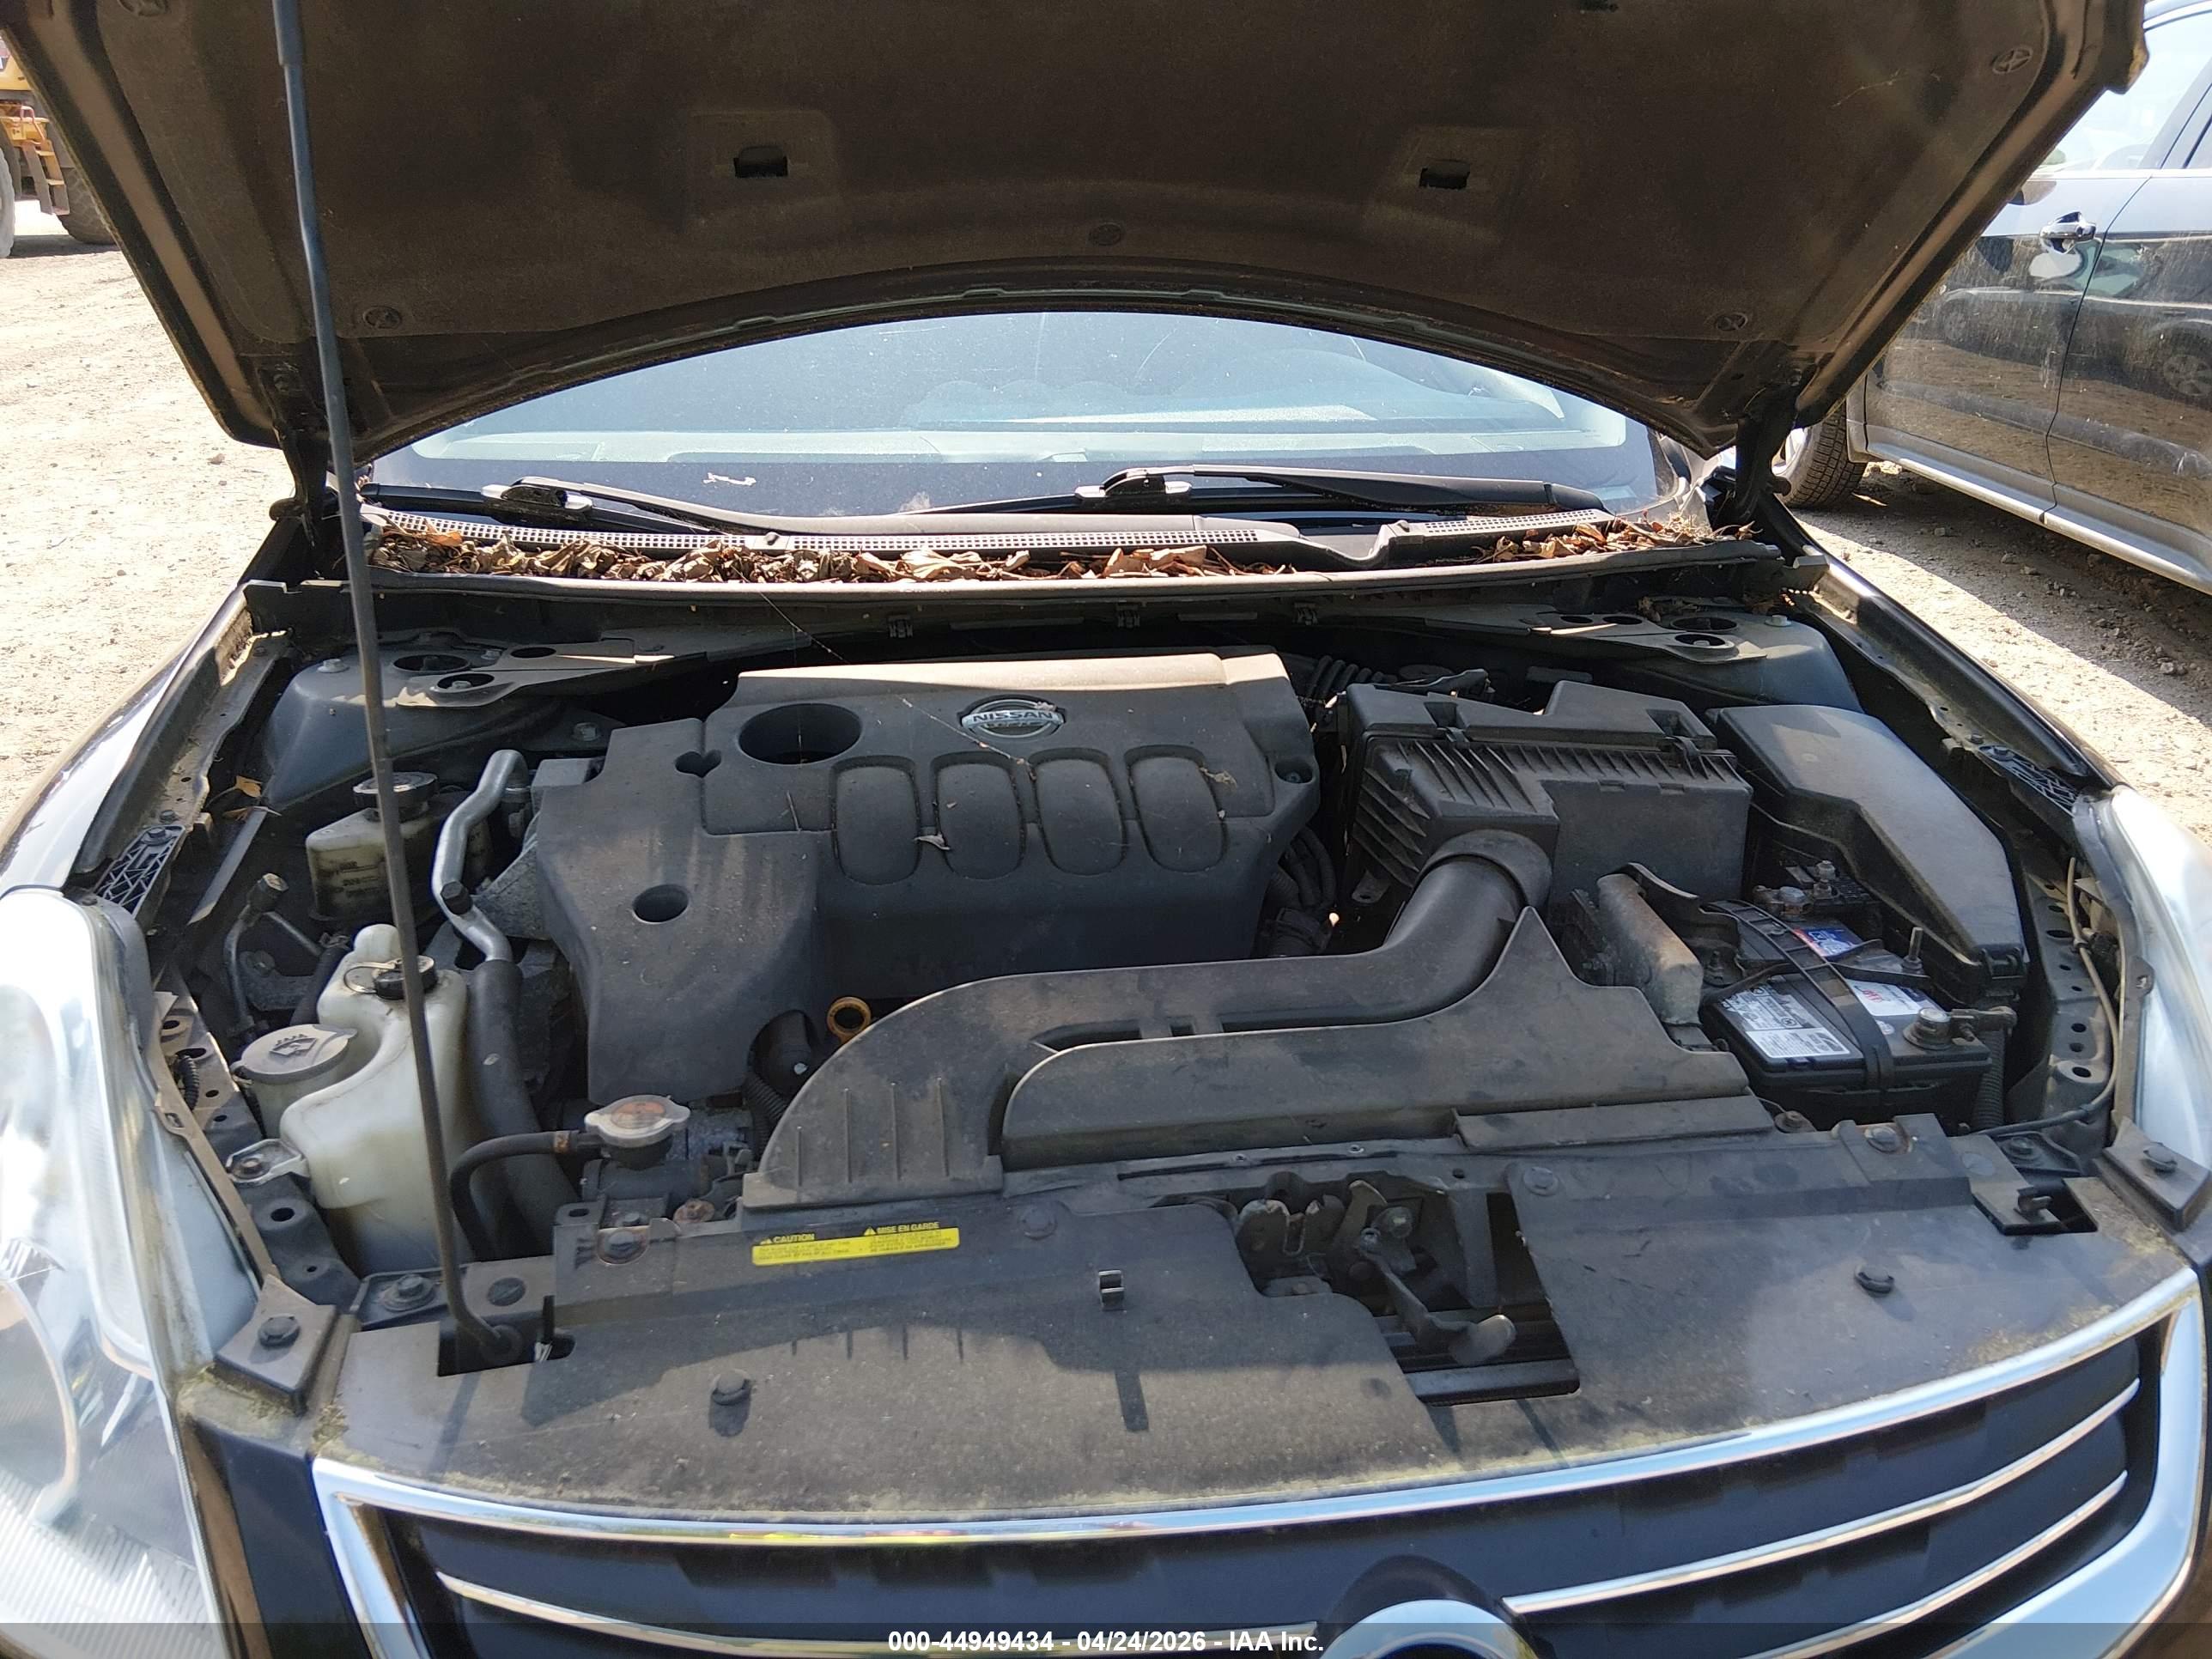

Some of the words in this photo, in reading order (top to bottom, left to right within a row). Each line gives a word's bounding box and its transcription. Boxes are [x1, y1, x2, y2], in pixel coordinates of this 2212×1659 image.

[973, 710, 1053, 722] NISSAN
[877, 1225, 897, 1235] MISE
[898, 1224, 910, 1233] EN
[911, 1221, 940, 1231] GARDE
[773, 1233, 815, 1243] CAUTION
